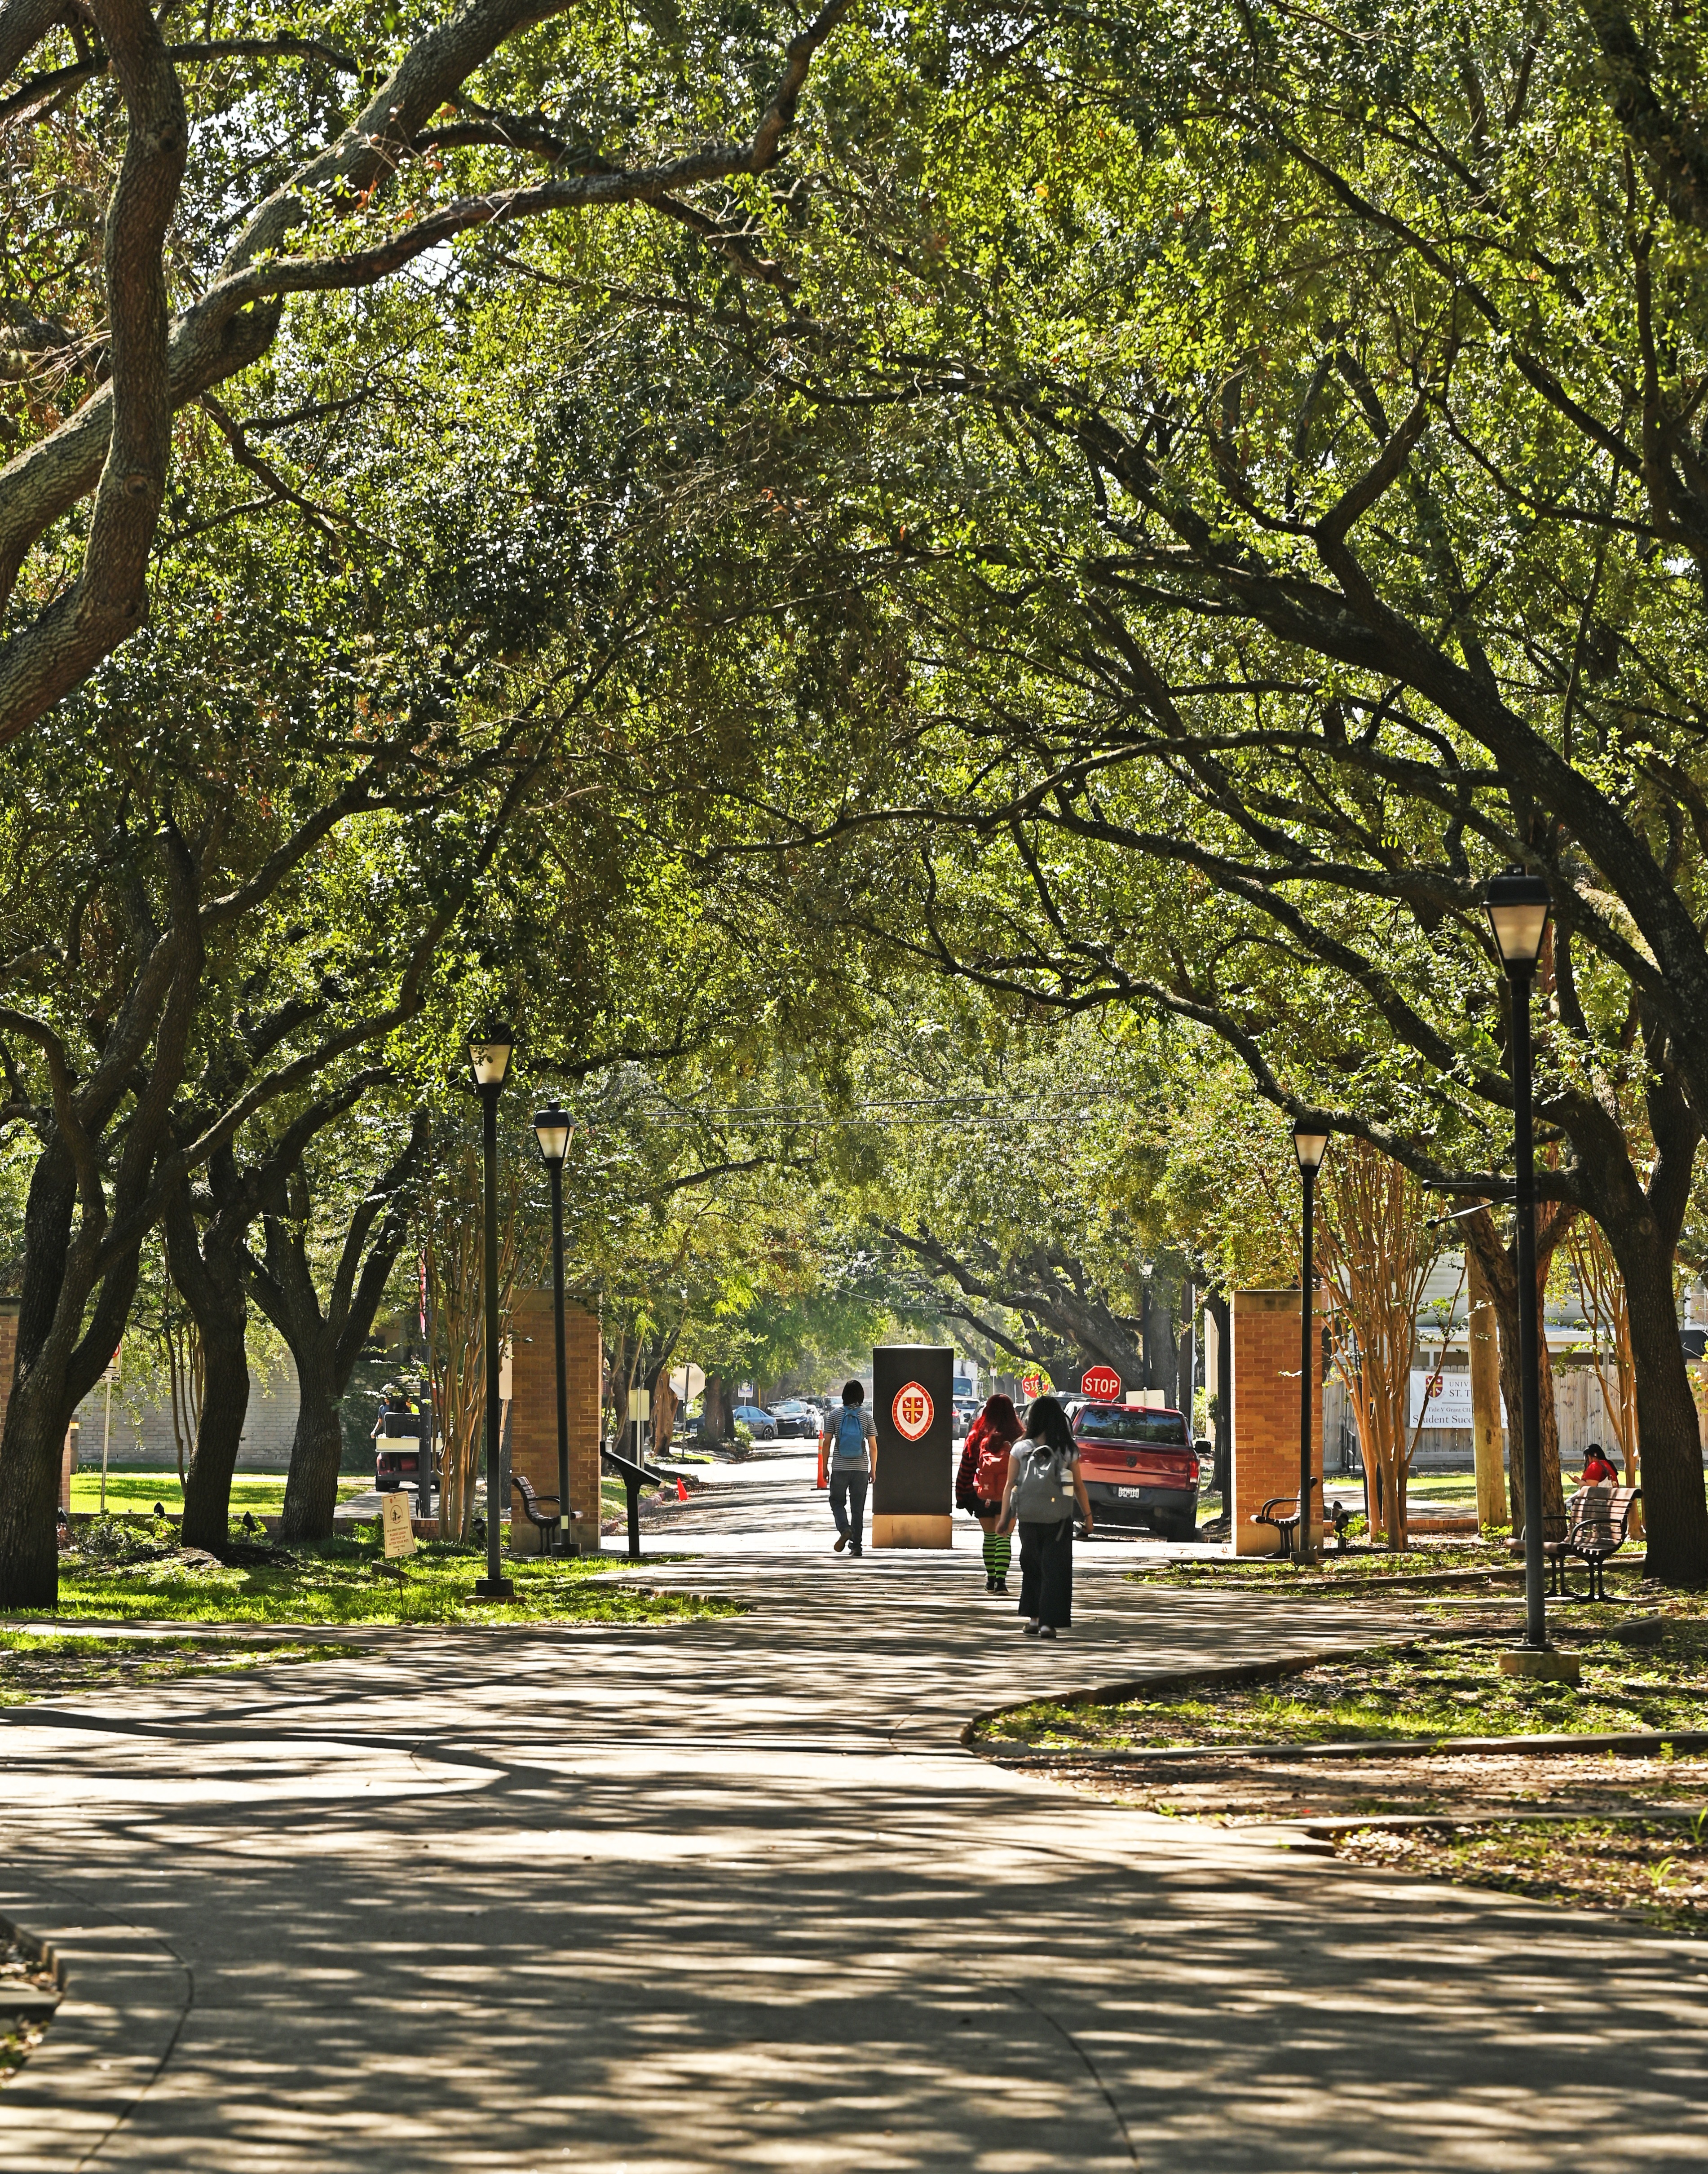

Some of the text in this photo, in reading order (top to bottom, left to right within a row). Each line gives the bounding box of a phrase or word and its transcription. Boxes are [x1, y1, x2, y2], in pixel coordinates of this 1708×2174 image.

[915, 1384, 931, 1405] SAINT
[1084, 1378, 1118, 1393] STOP
[893, 1392, 911, 1438] UNIVERSITY
[916, 1409, 933, 1438] THOMAS
[1413, 1414, 1449, 1423] Sudent
